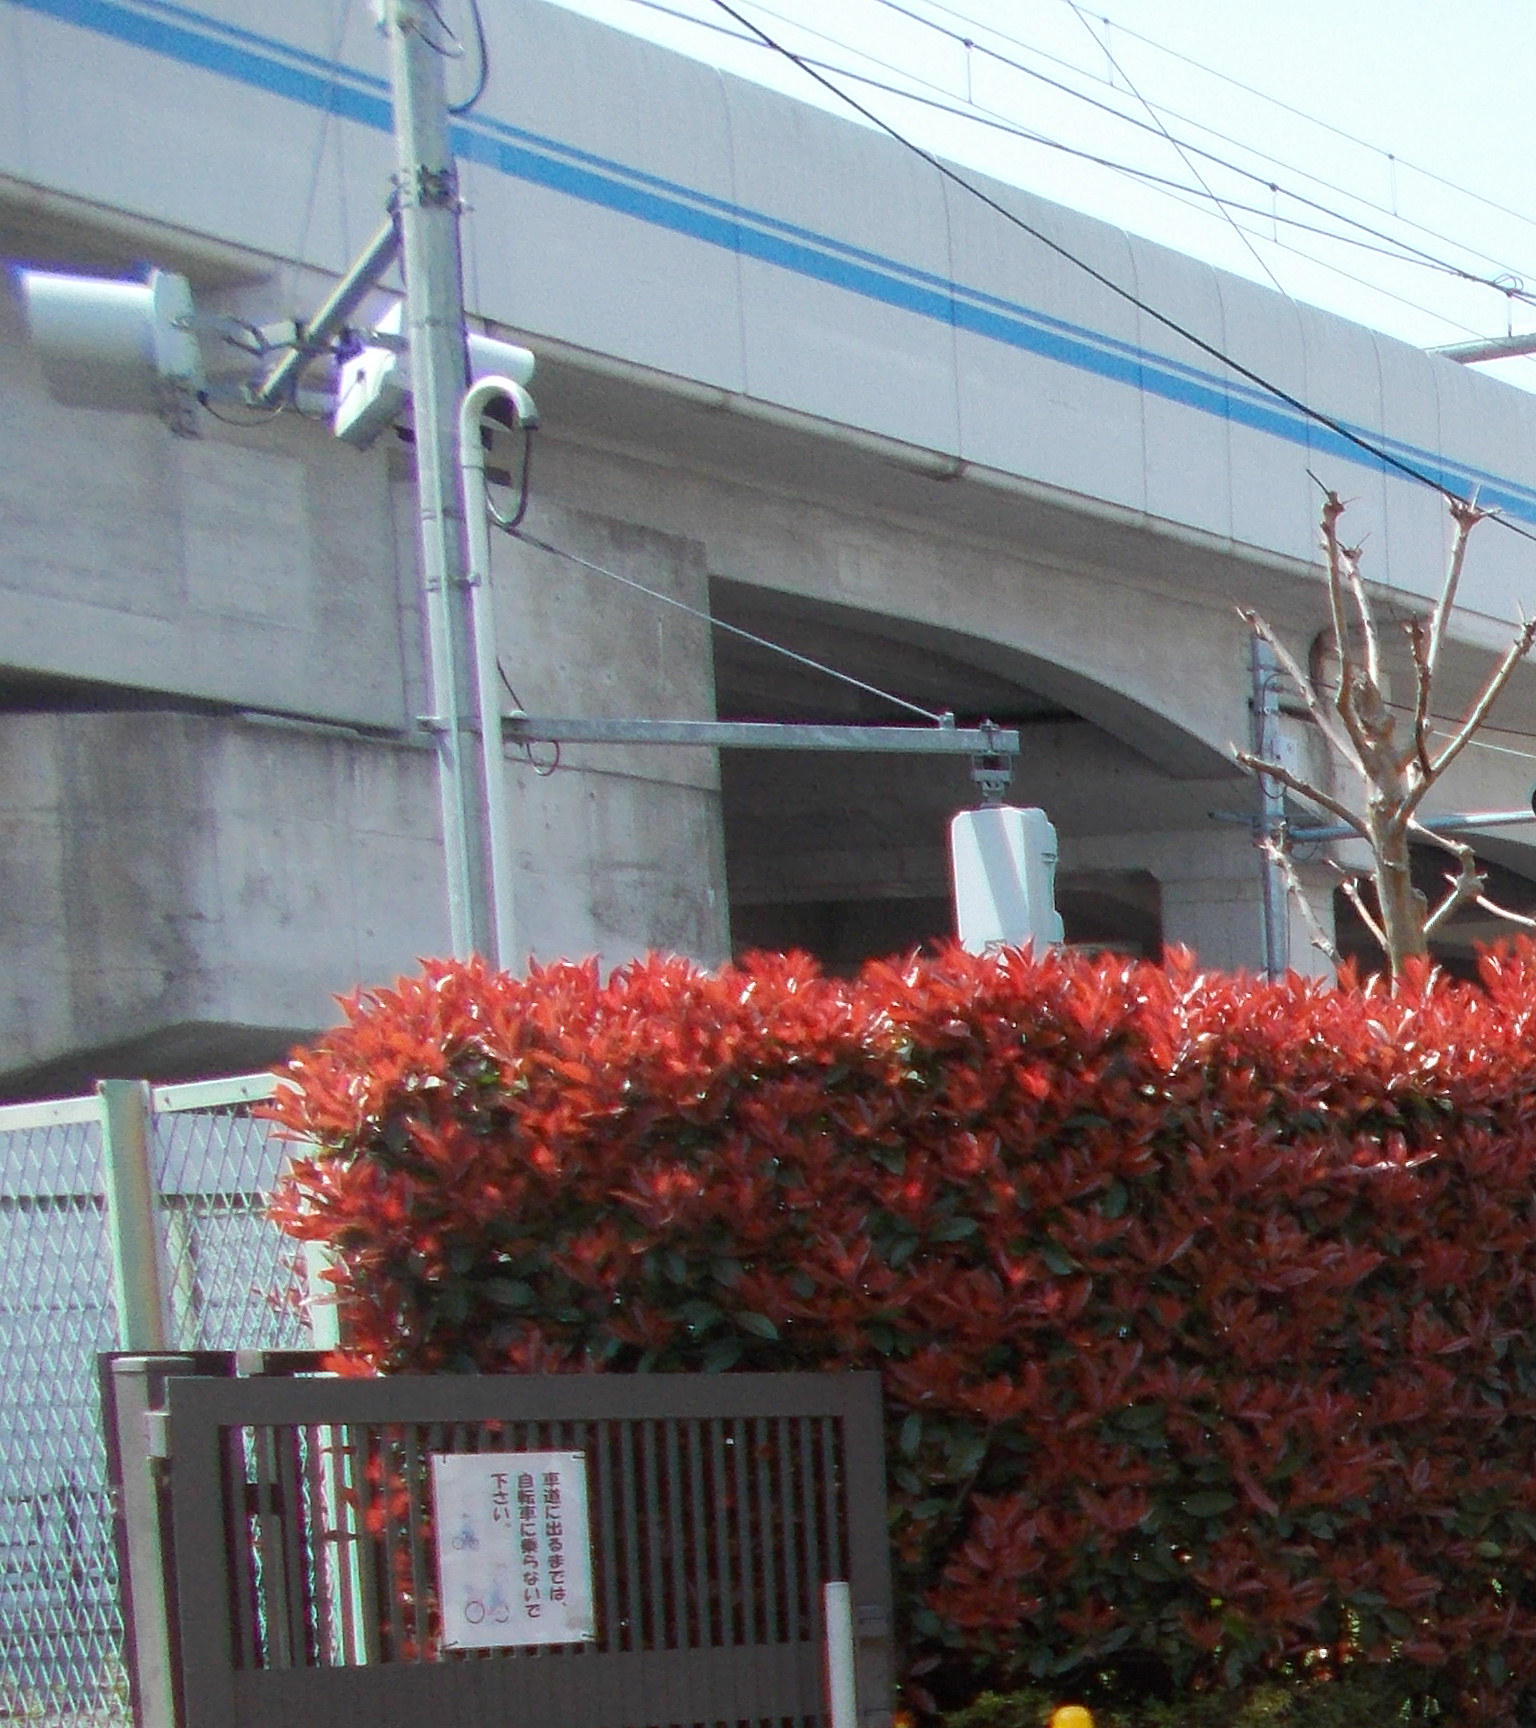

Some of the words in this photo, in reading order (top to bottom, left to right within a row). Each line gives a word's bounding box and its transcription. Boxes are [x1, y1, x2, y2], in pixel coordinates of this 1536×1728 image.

[490, 1472, 512, 1529] 下さい。
[517, 1472, 541, 1619] 自転車に乗らないで
